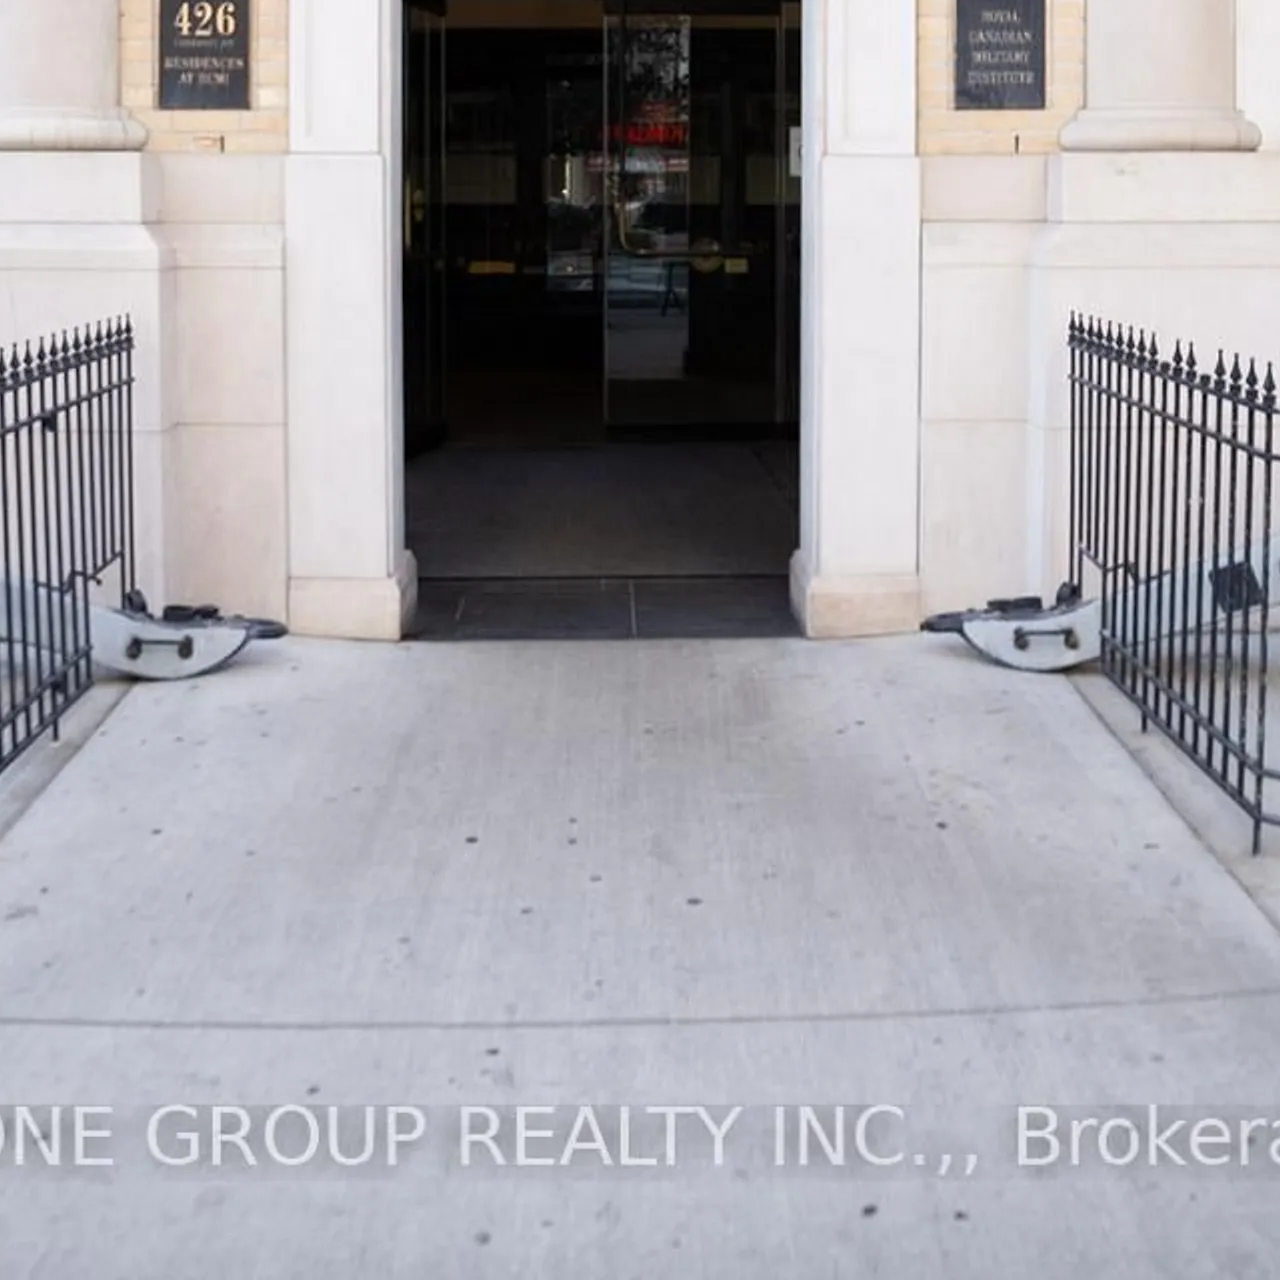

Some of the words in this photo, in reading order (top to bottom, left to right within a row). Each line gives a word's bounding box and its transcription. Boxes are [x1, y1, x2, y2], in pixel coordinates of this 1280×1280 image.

[173, 1, 236, 37] 426
[969, 31, 1033, 44] CANADIAN
[971, 50, 1030, 64] MILITARY
